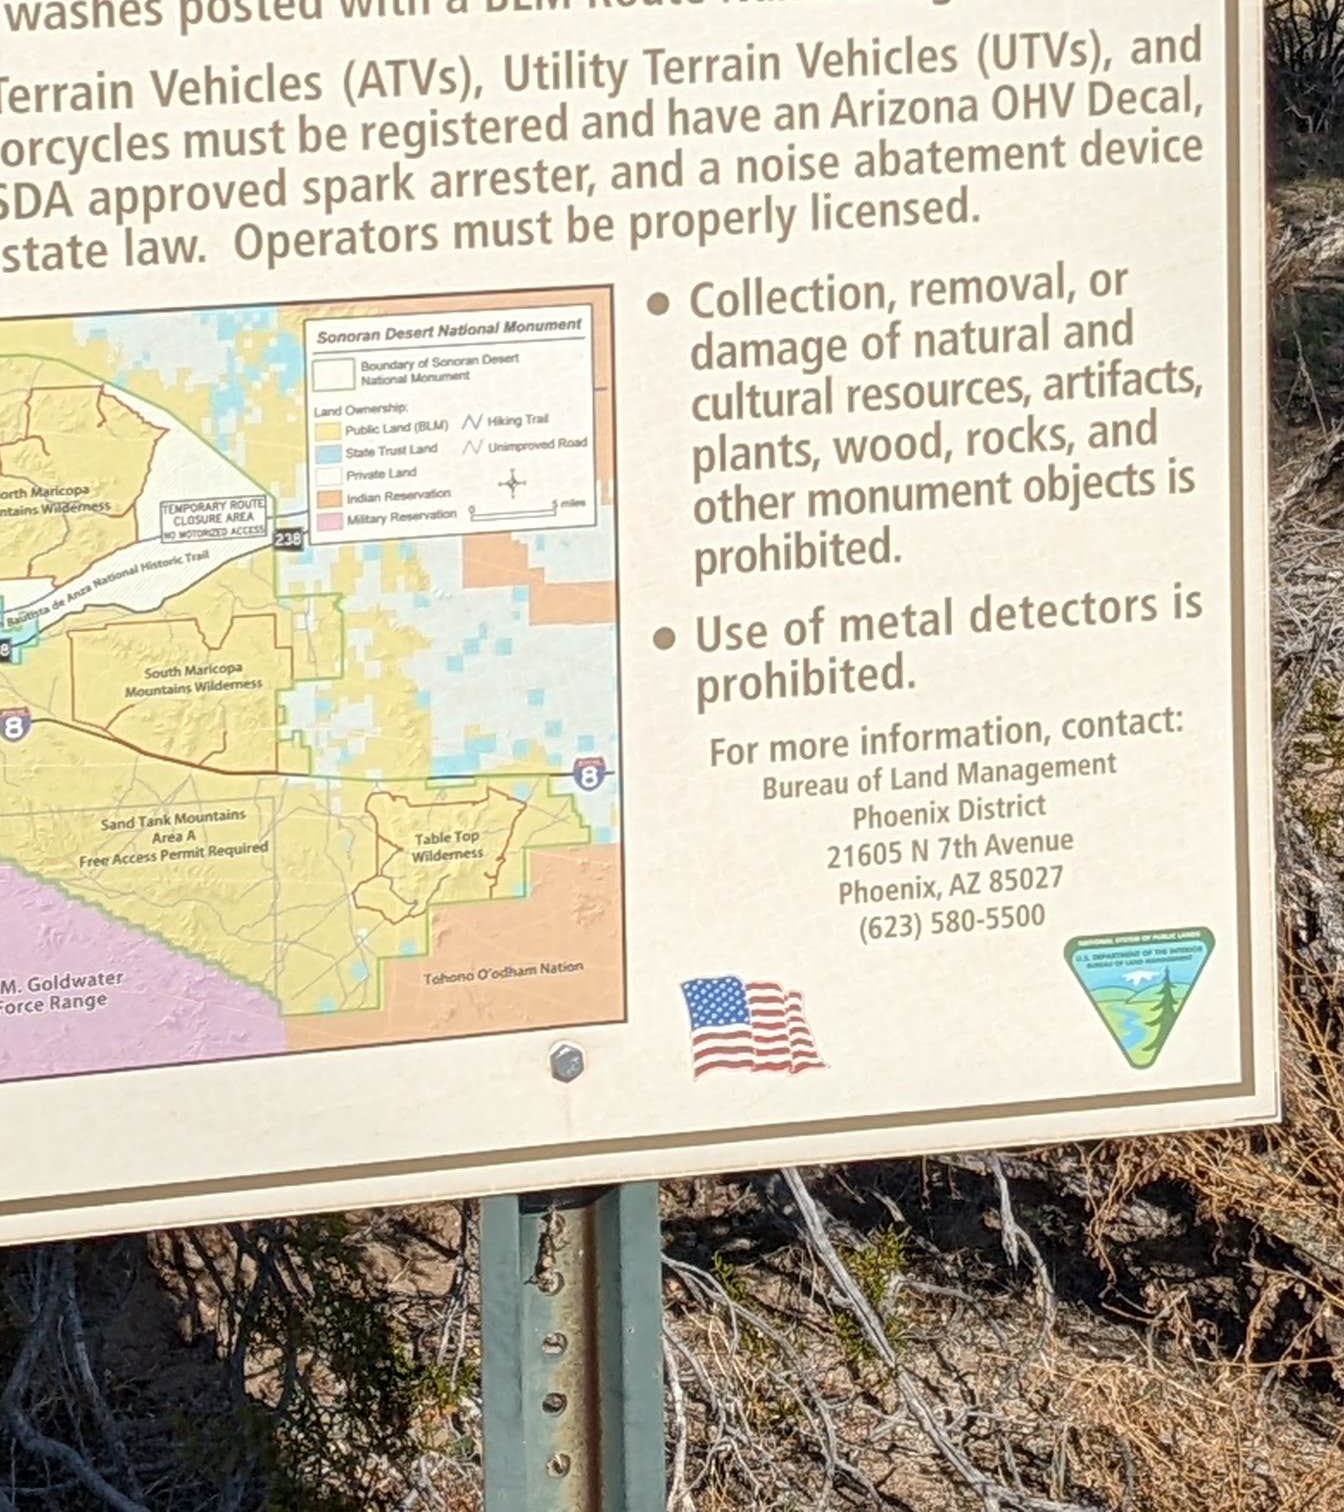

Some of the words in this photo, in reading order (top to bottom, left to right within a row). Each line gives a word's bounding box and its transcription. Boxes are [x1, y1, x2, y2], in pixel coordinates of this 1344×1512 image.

[149, 61, 323, 108] Vehicles
[343, 55, 483, 108] (ATVs),
[504, 49, 629, 99] Utility
[642, 47, 780, 86] Terrain
[795, 35, 958, 79] Vehicles
[977, 28, 1112, 80] (UTVs),
[1130, 22, 1202, 65] and
[88, 167, 286, 226] approved
[302, 160, 415, 216] spark
[430, 159, 596, 199] arrester,
[611, 147, 684, 191] and
[698, 157, 720, 186] a
[737, 143, 840, 184] noise
[854, 134, 1067, 178] abatement
[1080, 125, 1203, 167] device
[690, 273, 897, 319] Collection,
[910, 260, 1076, 308] removal,
[1089, 267, 1129, 297] or
[316, 330, 381, 345] Sonoran
[384, 326, 435, 341] Desert
[437, 321, 501, 337] National
[503, 317, 583, 334] Monument
[690, 330, 848, 376] damage
[861, 319, 902, 361] of
[914, 311, 1049, 358] natural
[1063, 306, 1133, 349] and
[693, 432, 820, 485] plants,
[832, 419, 953, 465] wood,
[967, 414, 1075, 457] rocks,
[1088, 406, 1158, 449] and
[31, 486, 89, 498] Maricopa
[693, 483, 796, 525] other
[808, 471, 1012, 518] monument
[1023, 462, 1156, 512] objects
[1168, 456, 1196, 495] is
[41, 501, 111, 513] Wilderness
[163, 502, 226, 514] TEMPORARY
[230, 499, 264, 509] ROUTE
[173, 514, 221, 526] CLOSURE
[226, 512, 254, 522] AREA
[274, 533, 302, 546] 238
[695, 524, 902, 587] prohibited.
[7, 607, 50, 626] Bautista
[67, 587, 92, 603] Anza
[93, 564, 138, 588] National
[141, 556, 182, 573] Historic
[185, 550, 210, 562] Trail
[696, 614, 768, 653] Use
[783, 605, 825, 647] of
[840, 596, 953, 643] metal
[970, 591, 1158, 633] detectors
[1174, 582, 1203, 619] is
[144, 667, 181, 679] South
[185, 663, 243, 676] Maricopa
[697, 650, 916, 715] prohibited.
[125, 683, 192, 698] Mountains
[194, 679, 263, 692] Wilderness
[5, 717, 24, 738] 8
[710, 737, 759, 767] For
[769, 735, 849, 763] more
[861, 715, 1051, 756] information,
[1061, 706, 1183, 740] contact:
[581, 767, 598, 785] 8
[763, 776, 848, 800] Bureau
[857, 766, 883, 793] of
[890, 762, 948, 791] Land
[957, 752, 1117, 787] Management
[101, 816, 135, 831] Sand
[140, 814, 171, 828] Tank
[174, 809, 246, 825] Mountains
[853, 800, 950, 831] Phoenix
[958, 793, 1047, 822] District
[152, 832, 183, 844] Area
[186, 830, 196, 841] A
[415, 832, 452, 846] Table
[454, 830, 480, 843] Top
[827, 840, 903, 869] 21605
[911, 838, 929, 863] N
[937, 833, 978, 860] 7th
[984, 833, 1074, 857] Avenue
[79, 855, 109, 868] Free
[112, 850, 157, 865] Access
[160, 847, 205, 862] Permit
[208, 840, 269, 858] Required
[412, 847, 484, 863] Wilderness
[839, 875, 943, 905] Phoenix,
[948, 871, 981, 897] AZ
[989, 864, 1063, 893] 85027
[859, 912, 922, 946] (623)
[931, 902, 1045, 935] 580-5500
[0, 980, 22, 994] M.
[28, 972, 123, 992] Goldwater
[424, 972, 474, 985] Tohono
[540, 961, 584, 974] Nation
[50, 994, 107, 1011] Range
